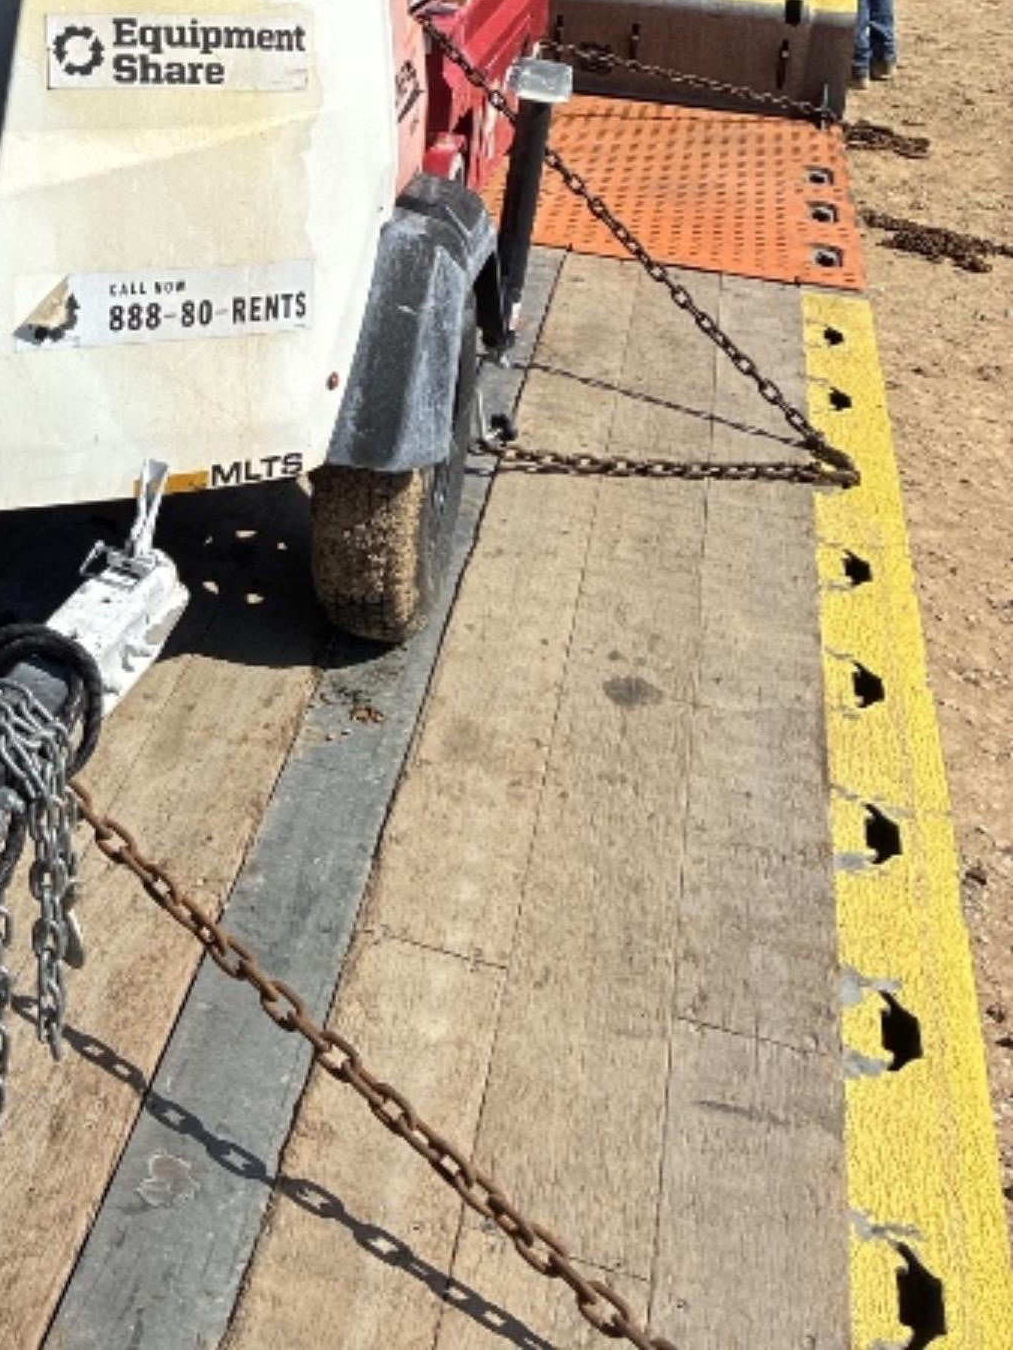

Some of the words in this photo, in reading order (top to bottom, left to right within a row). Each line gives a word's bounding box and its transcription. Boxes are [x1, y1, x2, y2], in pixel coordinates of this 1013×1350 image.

[112, 17, 306, 54] Equipment
[112, 54, 226, 85] Share
[109, 281, 147, 297] CALL
[154, 279, 186, 295] NOW
[211, 452, 303, 487] MLTS
